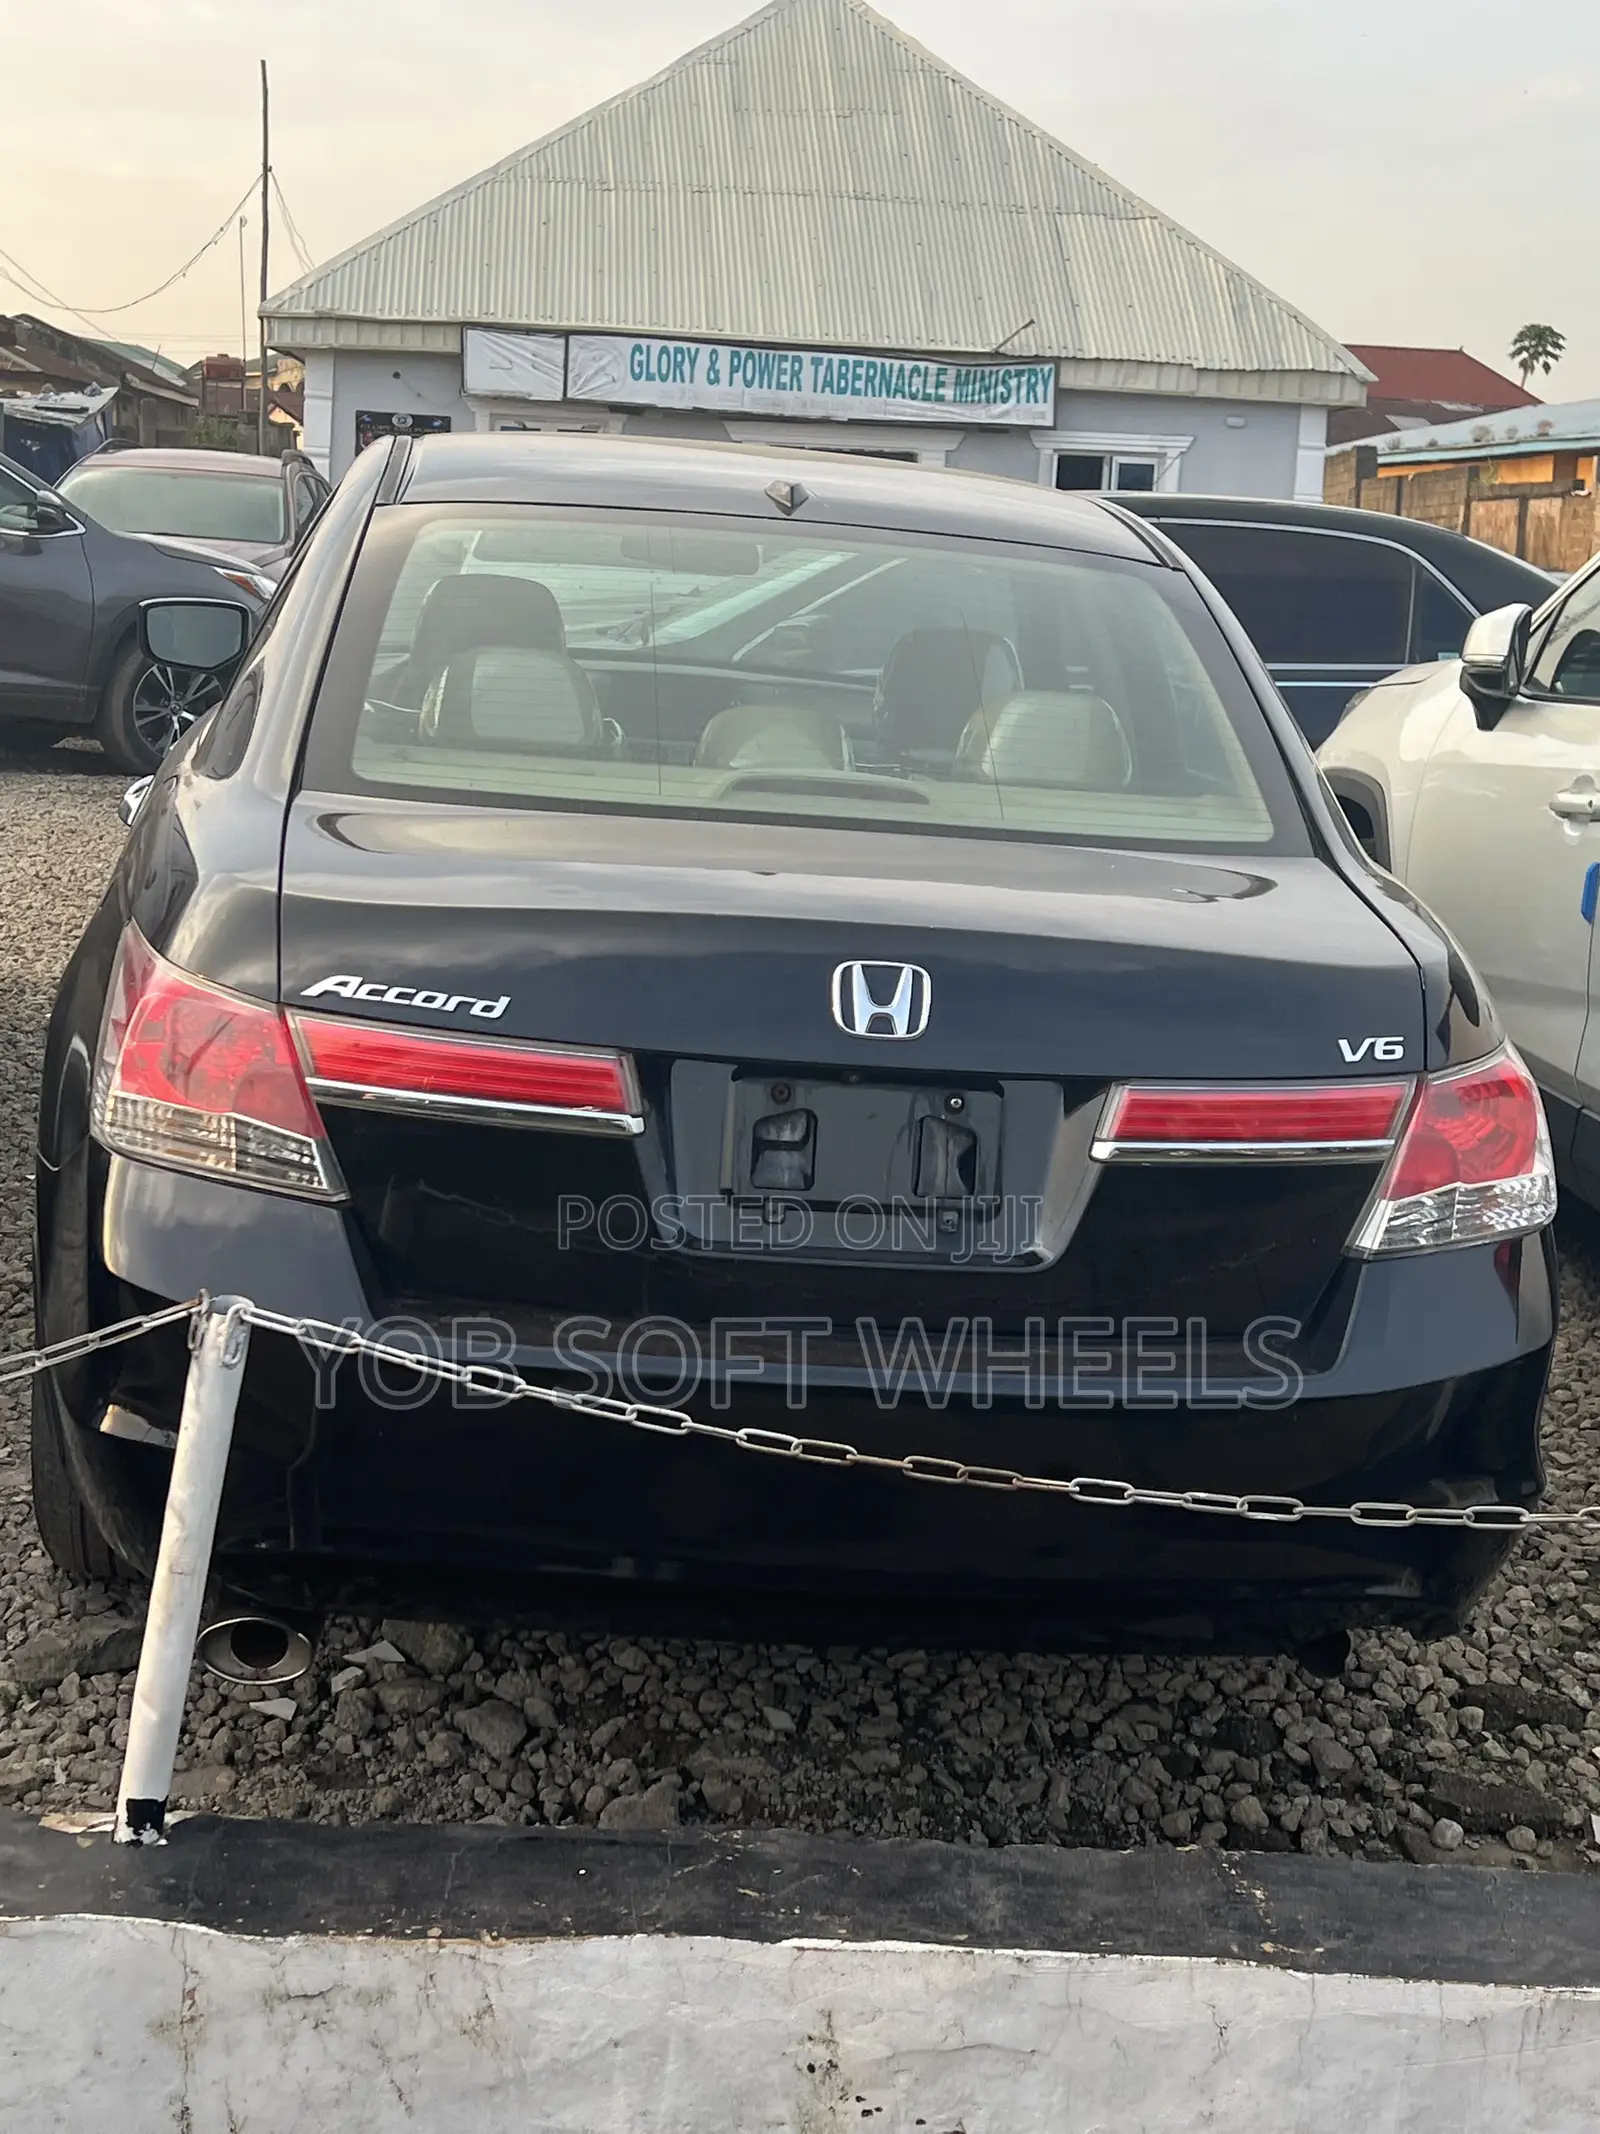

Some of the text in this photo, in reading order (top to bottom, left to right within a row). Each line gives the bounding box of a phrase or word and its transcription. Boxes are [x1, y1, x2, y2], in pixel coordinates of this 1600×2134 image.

[630, 343, 700, 384] GLORY
[706, 348, 720, 386] &
[728, 349, 803, 392] POWER
[811, 356, 948, 402] TABERNACLE
[952, 367, 1053, 405] MINISTRY
[300, 975, 511, 1019] Accord
[1338, 1036, 1404, 1063] V6
